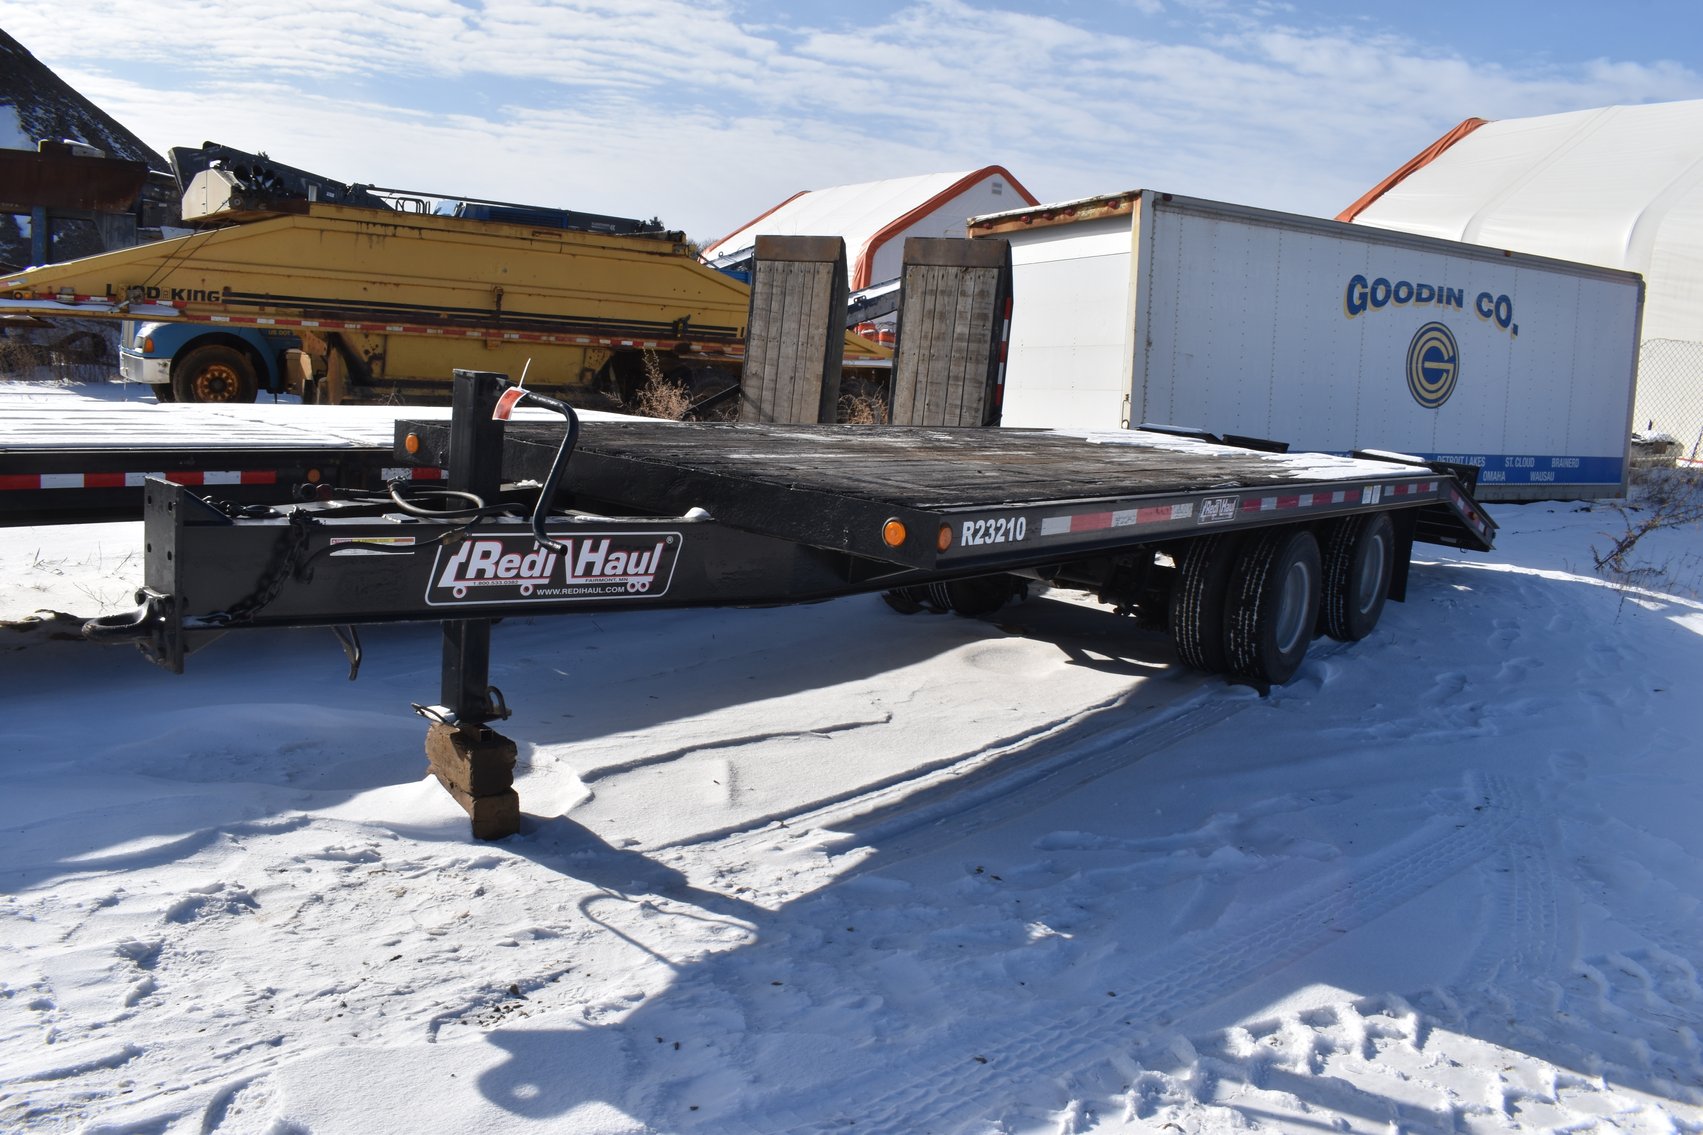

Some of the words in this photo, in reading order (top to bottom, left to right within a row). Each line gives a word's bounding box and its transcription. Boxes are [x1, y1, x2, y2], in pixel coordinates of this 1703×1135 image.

[1344, 274, 1464, 319] GOODIN
[1475, 291, 1519, 340] CO.
[1504, 456, 1514, 467] ST.
[1515, 456, 1535, 467] CLOUD
[1551, 457, 1580, 468] BRAINERD
[1482, 470, 1506, 482] OMAHA
[1530, 471, 1555, 482] WAUSAU
[960, 516, 1027, 547] R23210
[465, 540, 557, 579] Redi
[573, 539, 666, 577] Haul
[536, 586, 625, 596] WWW.REDIHAUL.COM
